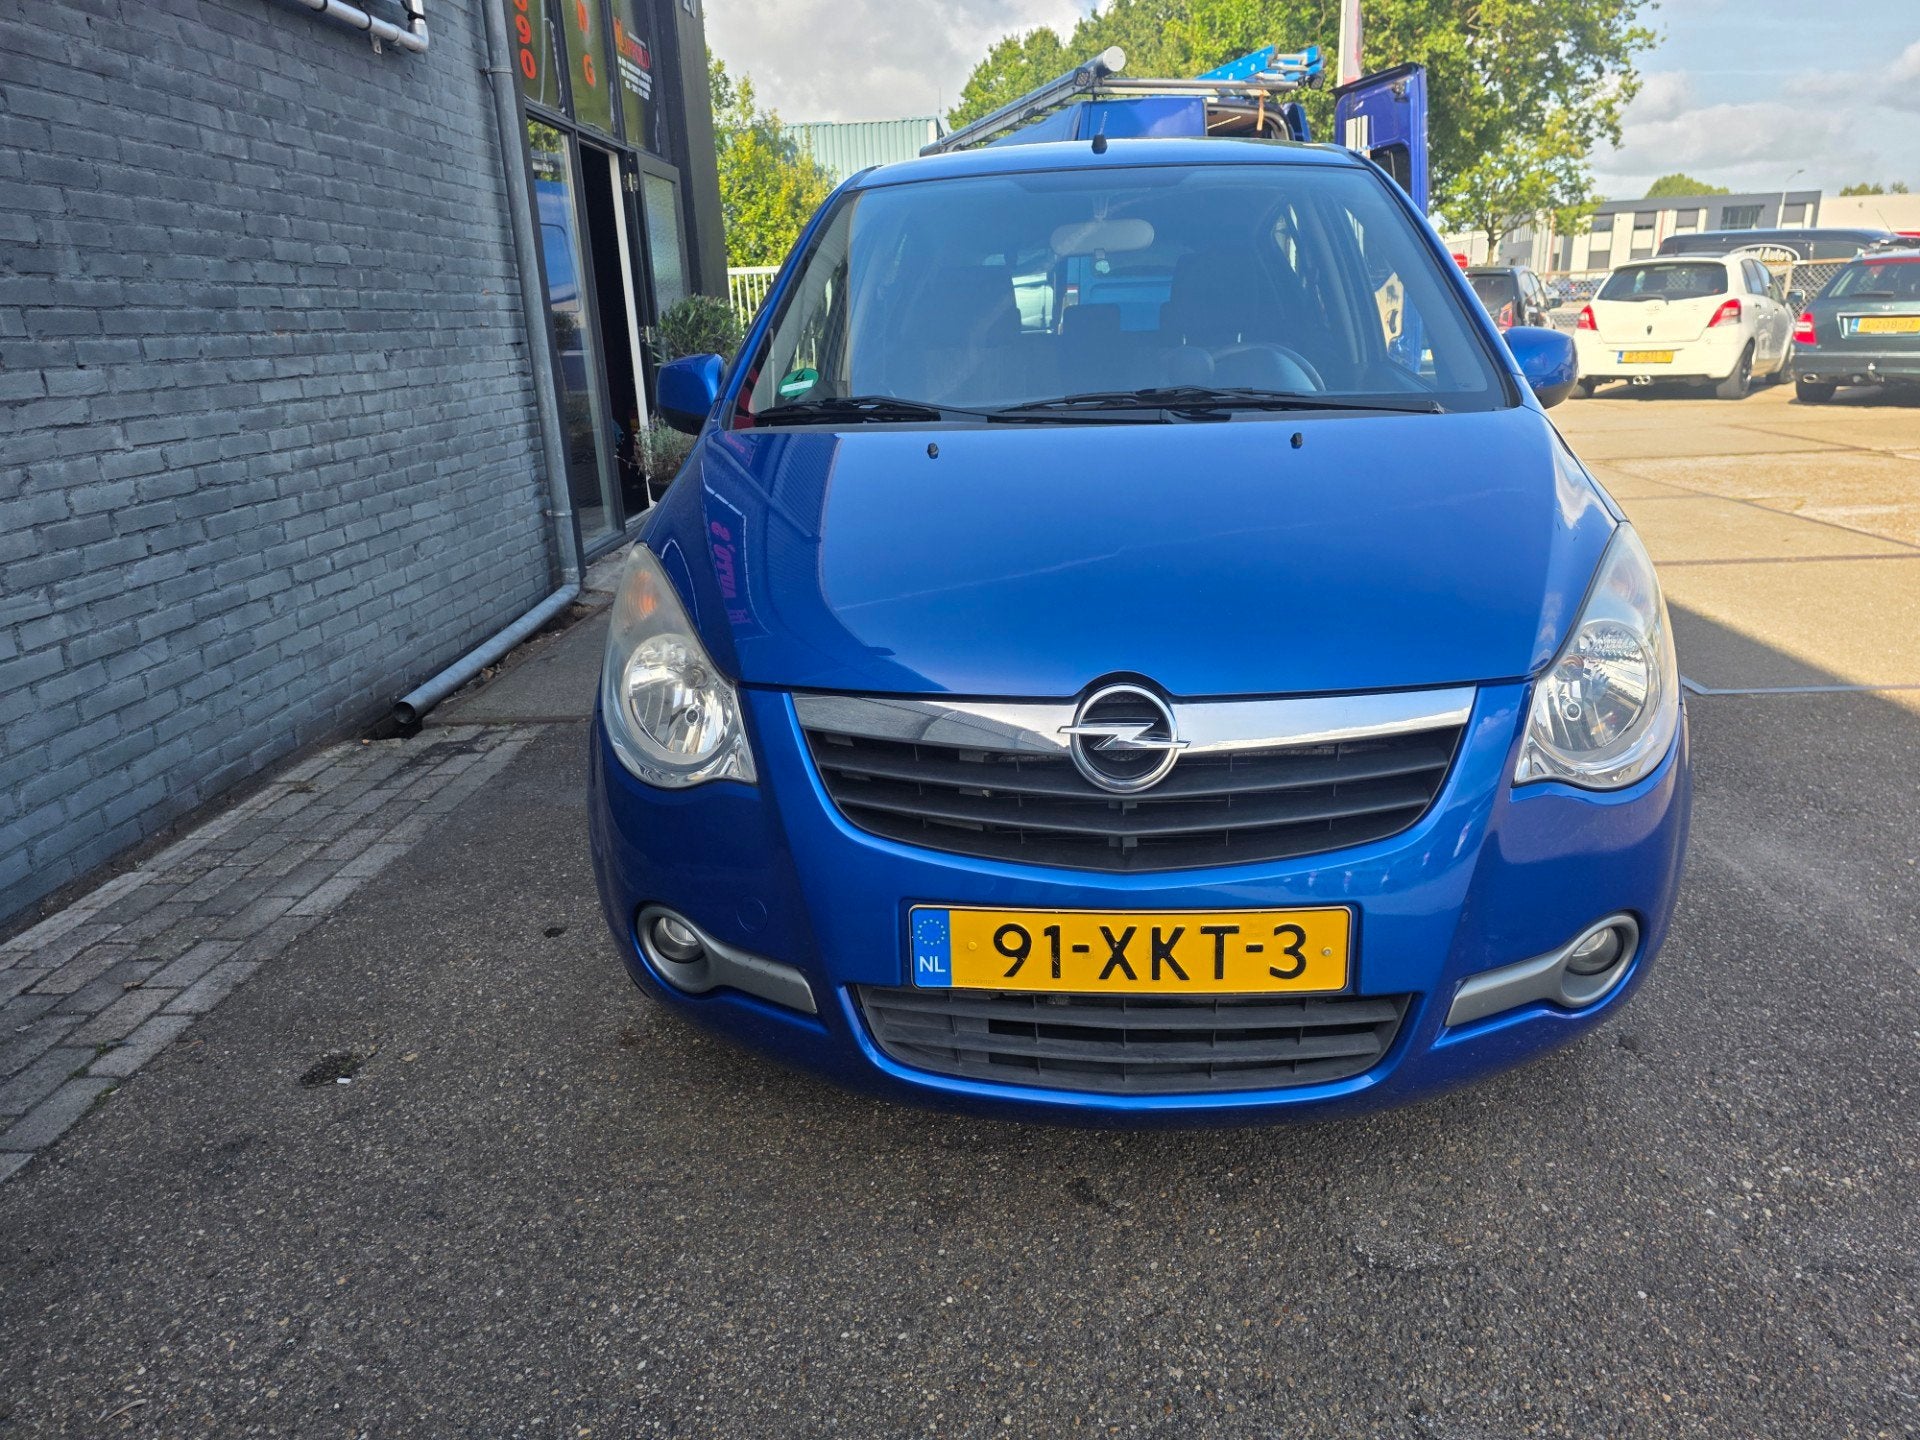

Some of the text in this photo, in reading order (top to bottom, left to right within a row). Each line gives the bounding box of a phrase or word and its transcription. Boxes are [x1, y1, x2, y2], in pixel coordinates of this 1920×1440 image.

[793, 370, 806, 382] 4
[993, 922, 1307, 981] 91-XKT-3
[919, 956, 946, 973] NL
